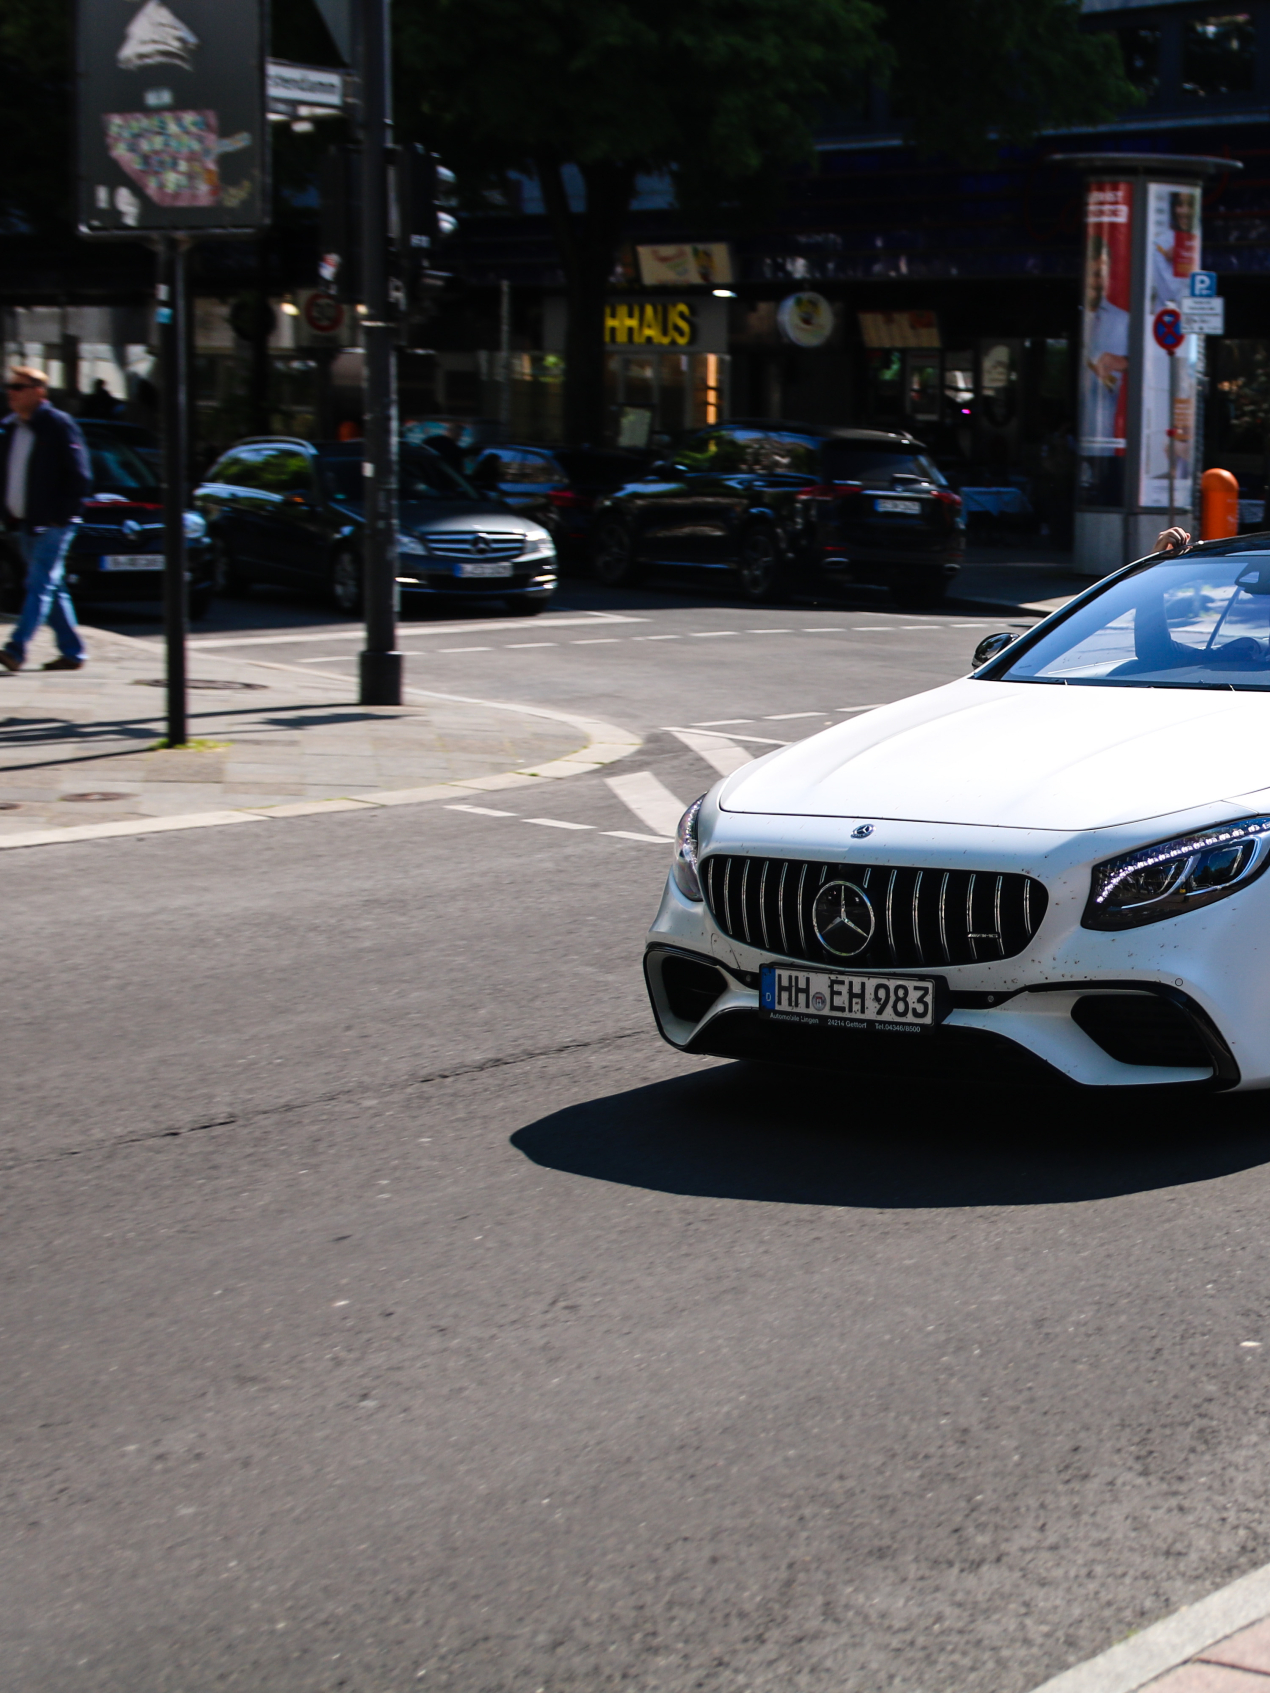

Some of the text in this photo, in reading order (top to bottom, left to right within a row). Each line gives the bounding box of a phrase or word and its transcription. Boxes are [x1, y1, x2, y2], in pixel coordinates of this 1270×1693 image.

[604, 302, 691, 345] HHAUS
[777, 974, 930, 1019] HH EH 983
